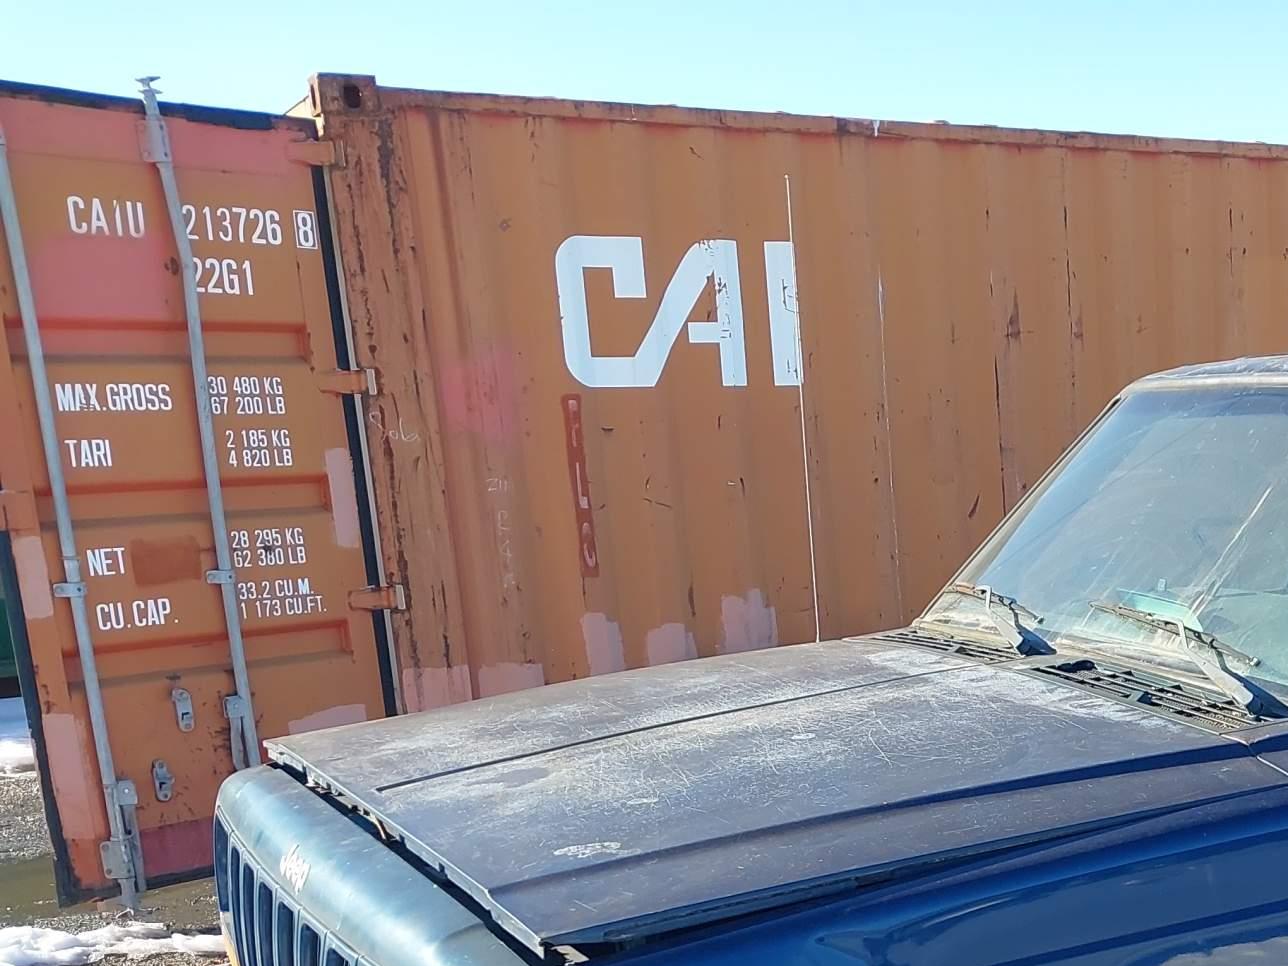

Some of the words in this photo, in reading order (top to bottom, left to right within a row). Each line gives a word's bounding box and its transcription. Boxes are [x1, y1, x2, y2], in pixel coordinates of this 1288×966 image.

[66, 195, 145, 238] CAIU
[181, 204, 283, 245] 213726
[295, 211, 316, 248] 8
[191, 256, 255, 296] 22G1
[555, 235, 804, 388] CAI
[207, 376, 227, 395] 30
[233, 376, 260, 395] 480
[263, 376, 283, 395] KG
[211, 396, 228, 415] 67
[236, 396, 263, 415] 200
[268, 396, 286, 415] LB
[225, 430, 235, 448] 2
[240, 429, 267, 447] 185
[271, 428, 290, 447] KG
[64, 438, 113, 468] TARI
[228, 449, 238, 468] 4
[243, 449, 270, 467] 820
[274, 448, 293, 467] LB
[230, 530, 249, 549] 28
[254, 528, 282, 547] 295
[285, 527, 304, 546] KG
[86, 547, 126, 577] NET
[233, 550, 252, 568] 62
[257, 547, 285, 566] 380
[289, 546, 306, 565] LB
[237, 580, 272, 600] 33.2
[274, 577, 315, 598] CU.M.
[239, 603, 248, 619] 1
[255, 600, 281, 618] 173
